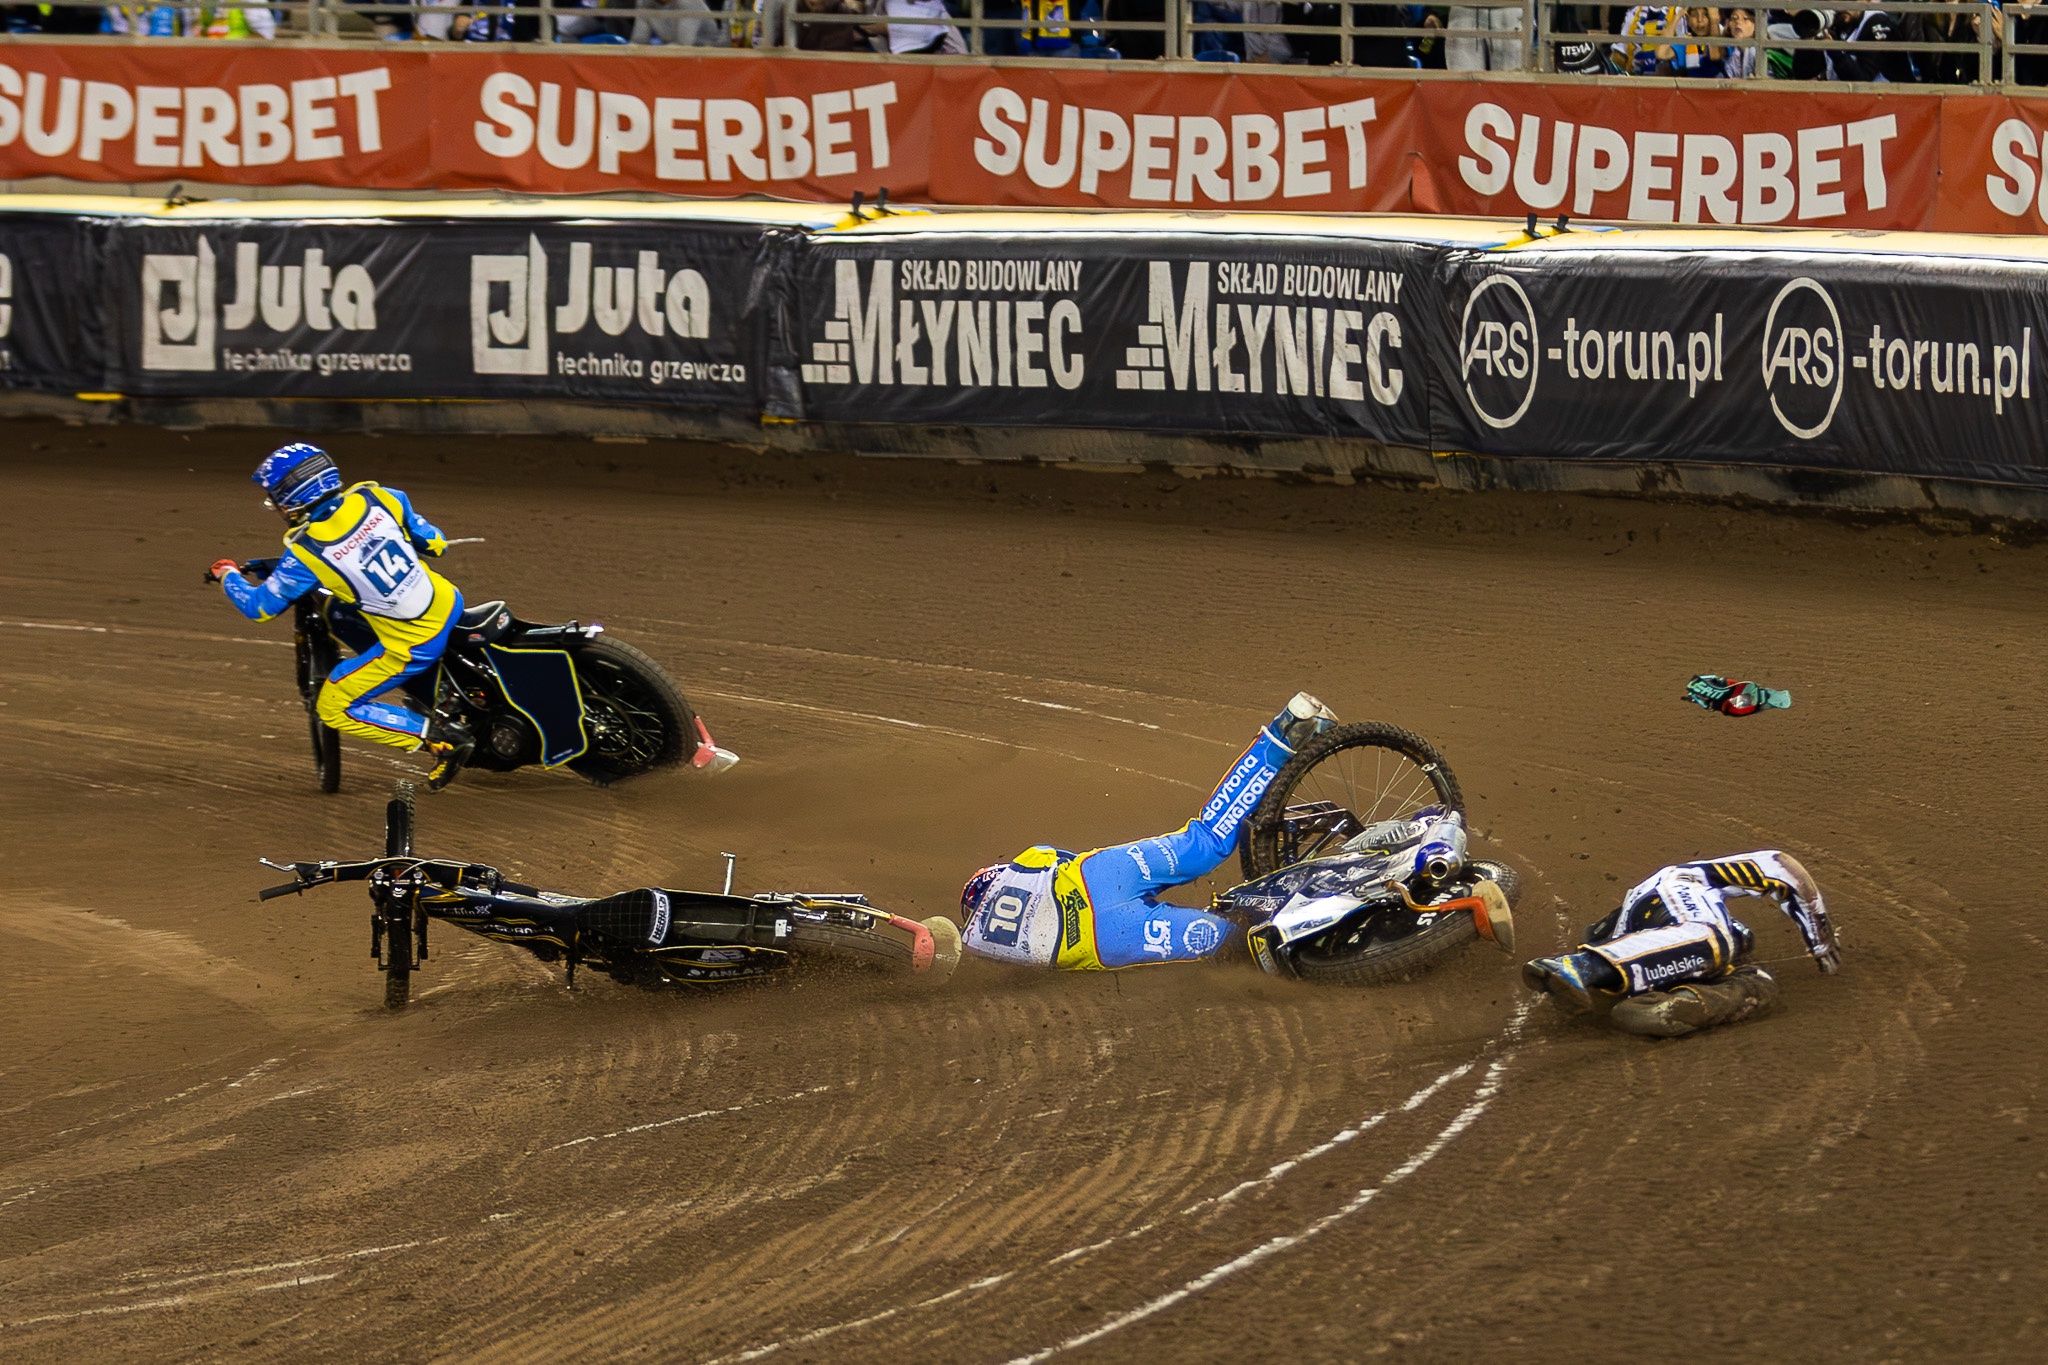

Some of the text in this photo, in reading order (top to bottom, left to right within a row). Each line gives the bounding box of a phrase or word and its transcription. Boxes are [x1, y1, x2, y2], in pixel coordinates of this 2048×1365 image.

[474, 72, 897, 181] SUPERBET
[974, 87, 1377, 202] SUPERBET
[1458, 102, 1898, 225] SUPERBET
[1986, 118, 2048, 217] S
[223, 242, 378, 332] Juta
[555, 242, 710, 338] Juta
[900, 259, 1083, 292] SKŁAD BUDOWLANY
[1217, 262, 1404, 304] SKŁAD BUDOWLANY
[223, 349, 412, 376] technika grzewcza
[834, 259, 1085, 390] MŁYNIEC
[1148, 261, 1404, 406] MŁYNIEC
[1465, 312, 1723, 398] ARS -torun.pl
[556, 351, 746, 385] technika grzewcza
[1770, 324, 2031, 415] ARS -torun.pl
[366, 549, 410, 589] 14
[1202, 754, 1259, 823] daytona
[989, 895, 1023, 933] 10
[1143, 919, 1165, 959] JG
[1644, 954, 1705, 981] lubelskie
